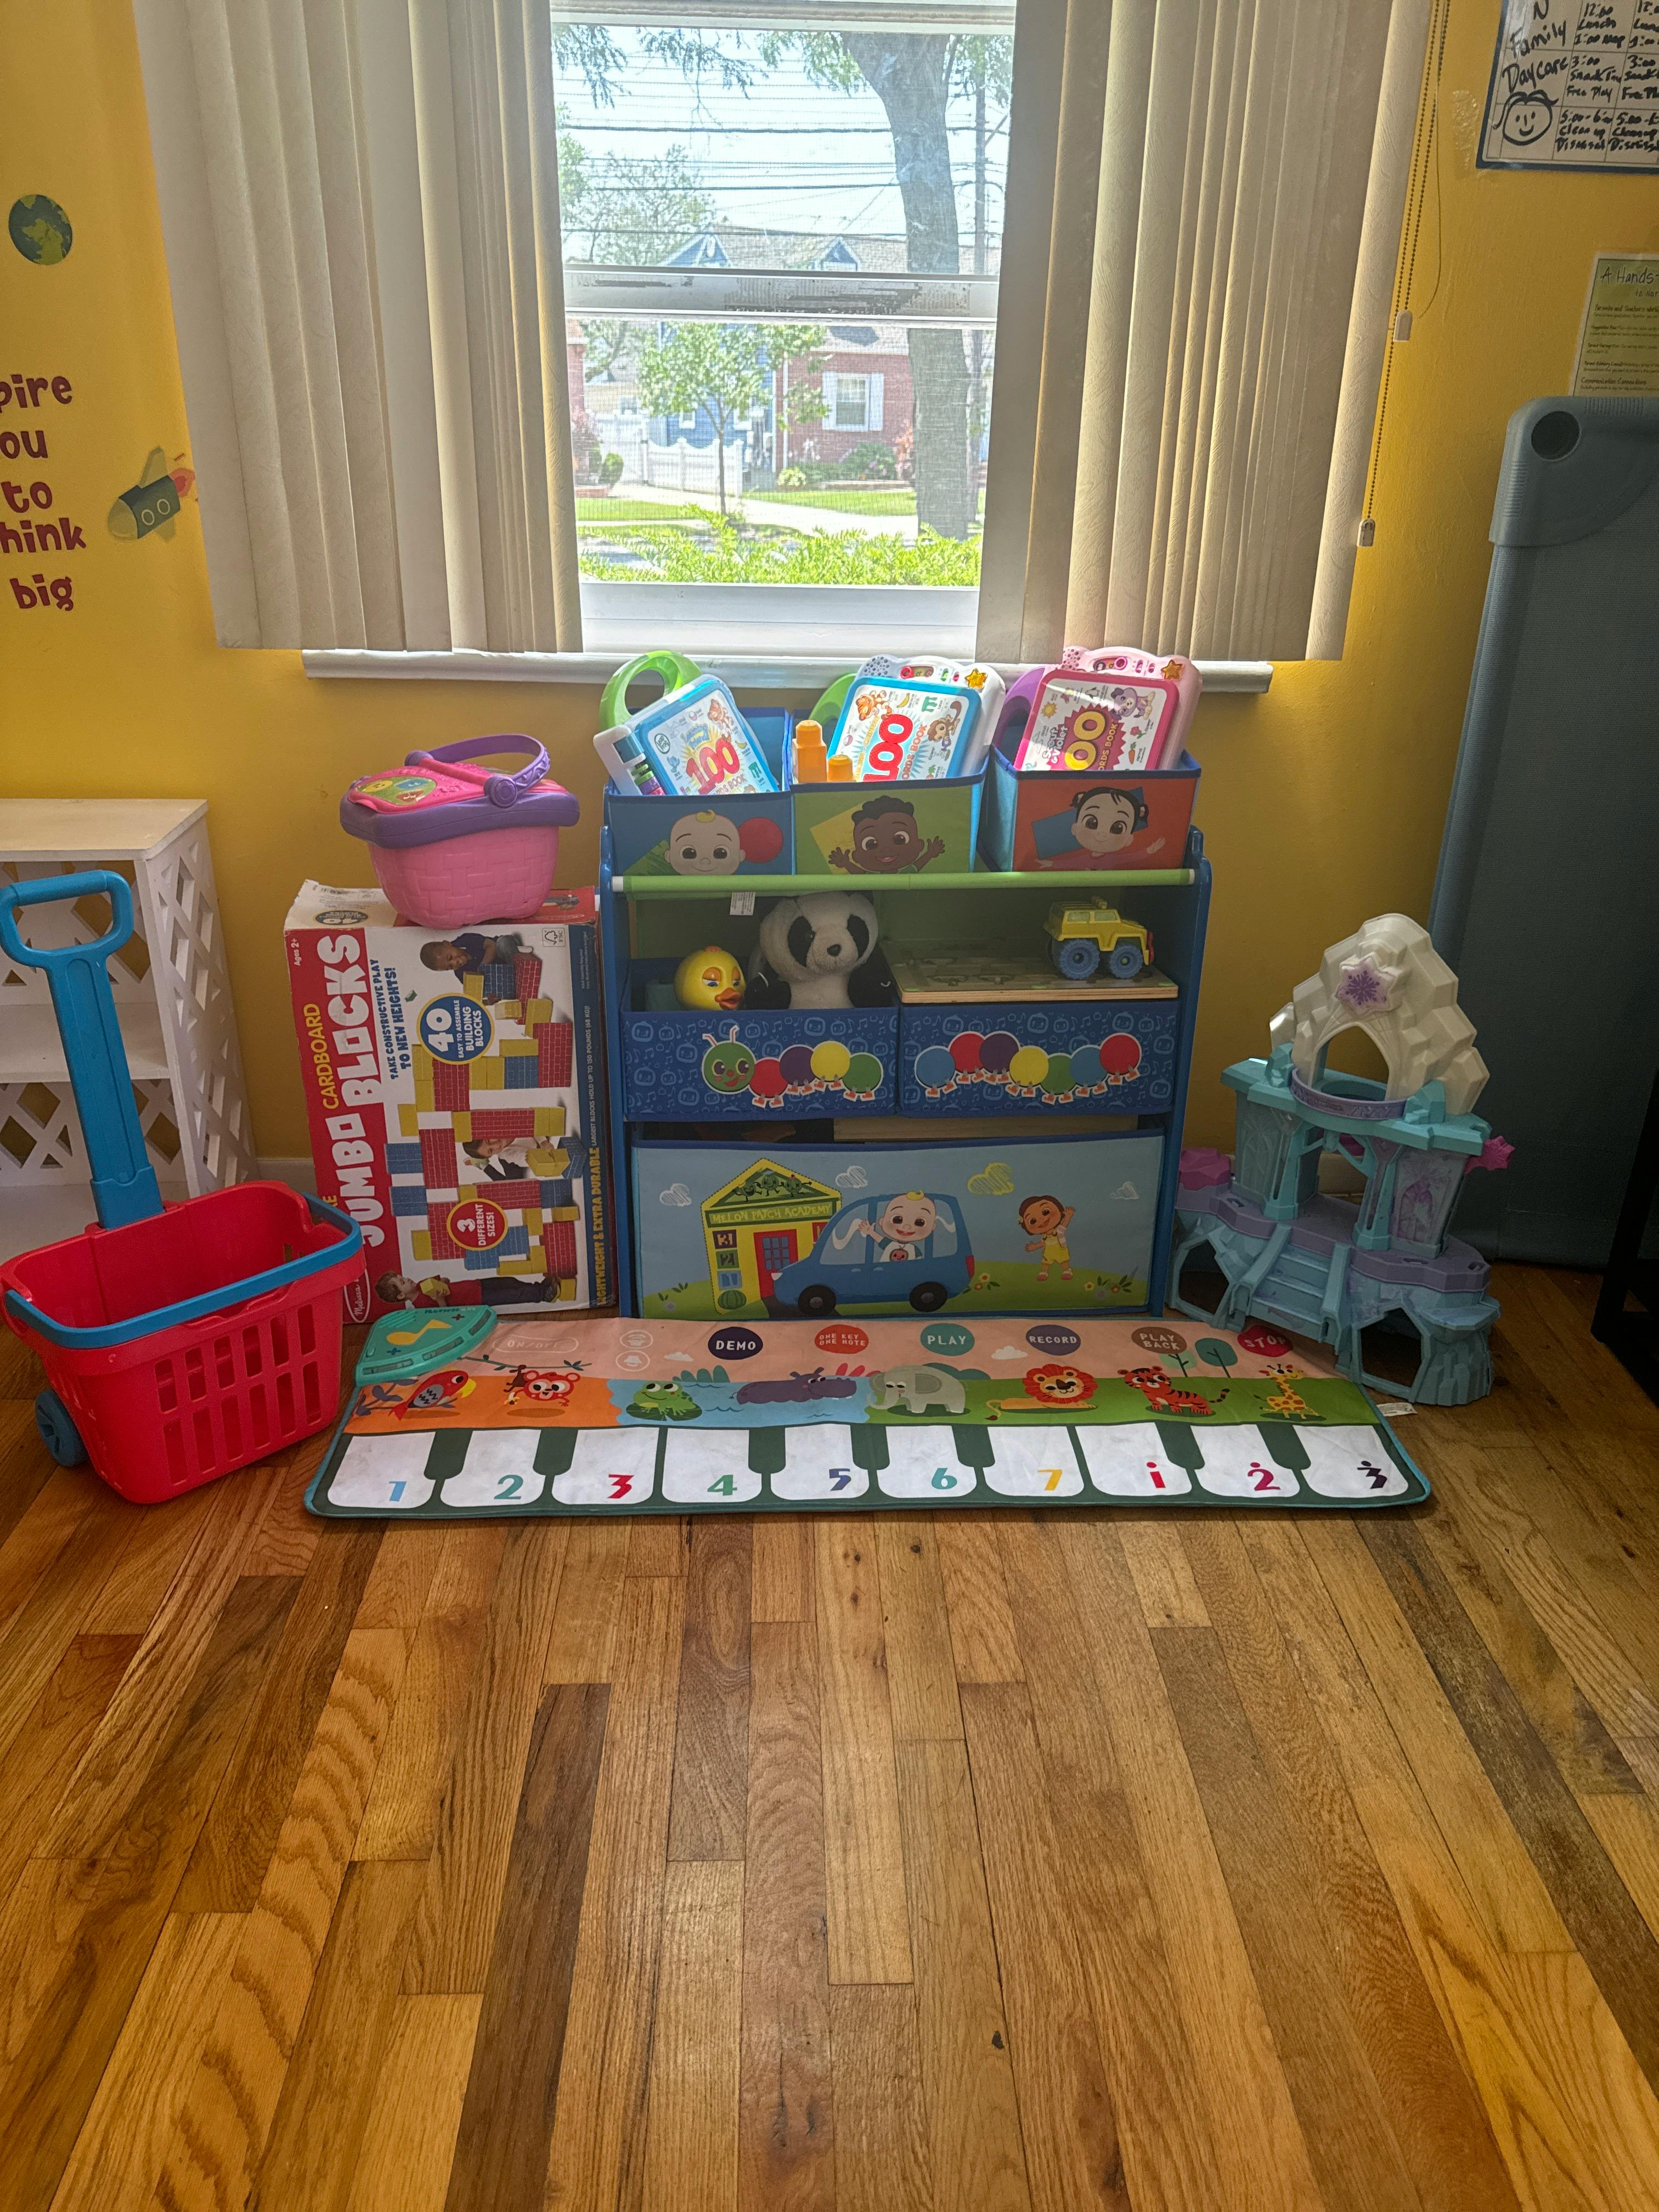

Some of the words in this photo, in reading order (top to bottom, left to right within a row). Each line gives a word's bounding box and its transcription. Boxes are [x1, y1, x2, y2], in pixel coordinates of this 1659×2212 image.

[1510, 20, 1566, 59] Family
[1590, 86, 1613, 103] Play
[1600, 266, 1612, 284] A
[1646, 289, 1659, 298] Nor
[0, 374, 72, 414] pire
[0, 430, 49, 459] ou
[1, 481, 53, 514] to
[0, 517, 87, 554] hink
[9, 573, 75, 612] big
[901, 753, 915, 780] ORDS
[910, 724, 928, 752] BOOK
[1042, 727, 1059, 759] Scout
[1064, 711, 1105, 770] 00
[1097, 749, 1107, 770] ORDS
[1104, 722, 1118, 747] BOOK
[686, 737, 740, 795] 100
[726, 774, 747, 792] BOOK
[291, 938, 300, 949] 2+
[370, 959, 383, 984] PLAY
[383, 967, 404, 1024] HEIGHTS!
[317, 934, 383, 1107] BLOCKS
[376, 985, 397, 1054] CONSTRUCTIVE
[454, 999, 462, 1029] ASSEMBLE
[462, 1006, 475, 1051] BUILDING
[472, 1010, 483, 1047] BLOCKS
[394, 1025, 409, 1051] NEW
[426, 1008, 454, 1052] 40
[457, 1031, 462, 1039] TO
[303, 1003, 339, 1109] CARDBOARD
[386, 1056, 399, 1080] TAKE
[400, 1053, 411, 1074] TO
[587, 1074, 594, 1082] UP
[325, 1113, 385, 1248] JUMBO
[589, 1148, 601, 1194] DURABLE
[457, 1218, 476, 1233] 3
[475, 1204, 486, 1246] DIFFERENT
[487, 1212, 496, 1237] SIZES!
[591, 1197, 603, 1231] EXTRA
[713, 1211, 748, 1222] MELON
[752, 1210, 781, 1220] PATCH
[785, 1205, 831, 1216] ACADEMY
[716, 1340, 756, 1351] DEMO
[927, 1335, 966, 1345] PLAY
[1029, 1335, 1077, 1345] RECORD
[1140, 1333, 1176, 1343] PLAY
[1143, 1340, 1180, 1351] BACK
[1244, 1334, 1288, 1348] STOP
[388, 1481, 407, 1502] 1
[494, 1474, 522, 1500] 2
[607, 1474, 635, 1499] 3
[707, 1475, 738, 1497] 4
[828, 1468, 852, 1492] 5
[930, 1468, 957, 1489] 6
[1037, 1469, 1063, 1491] 7
